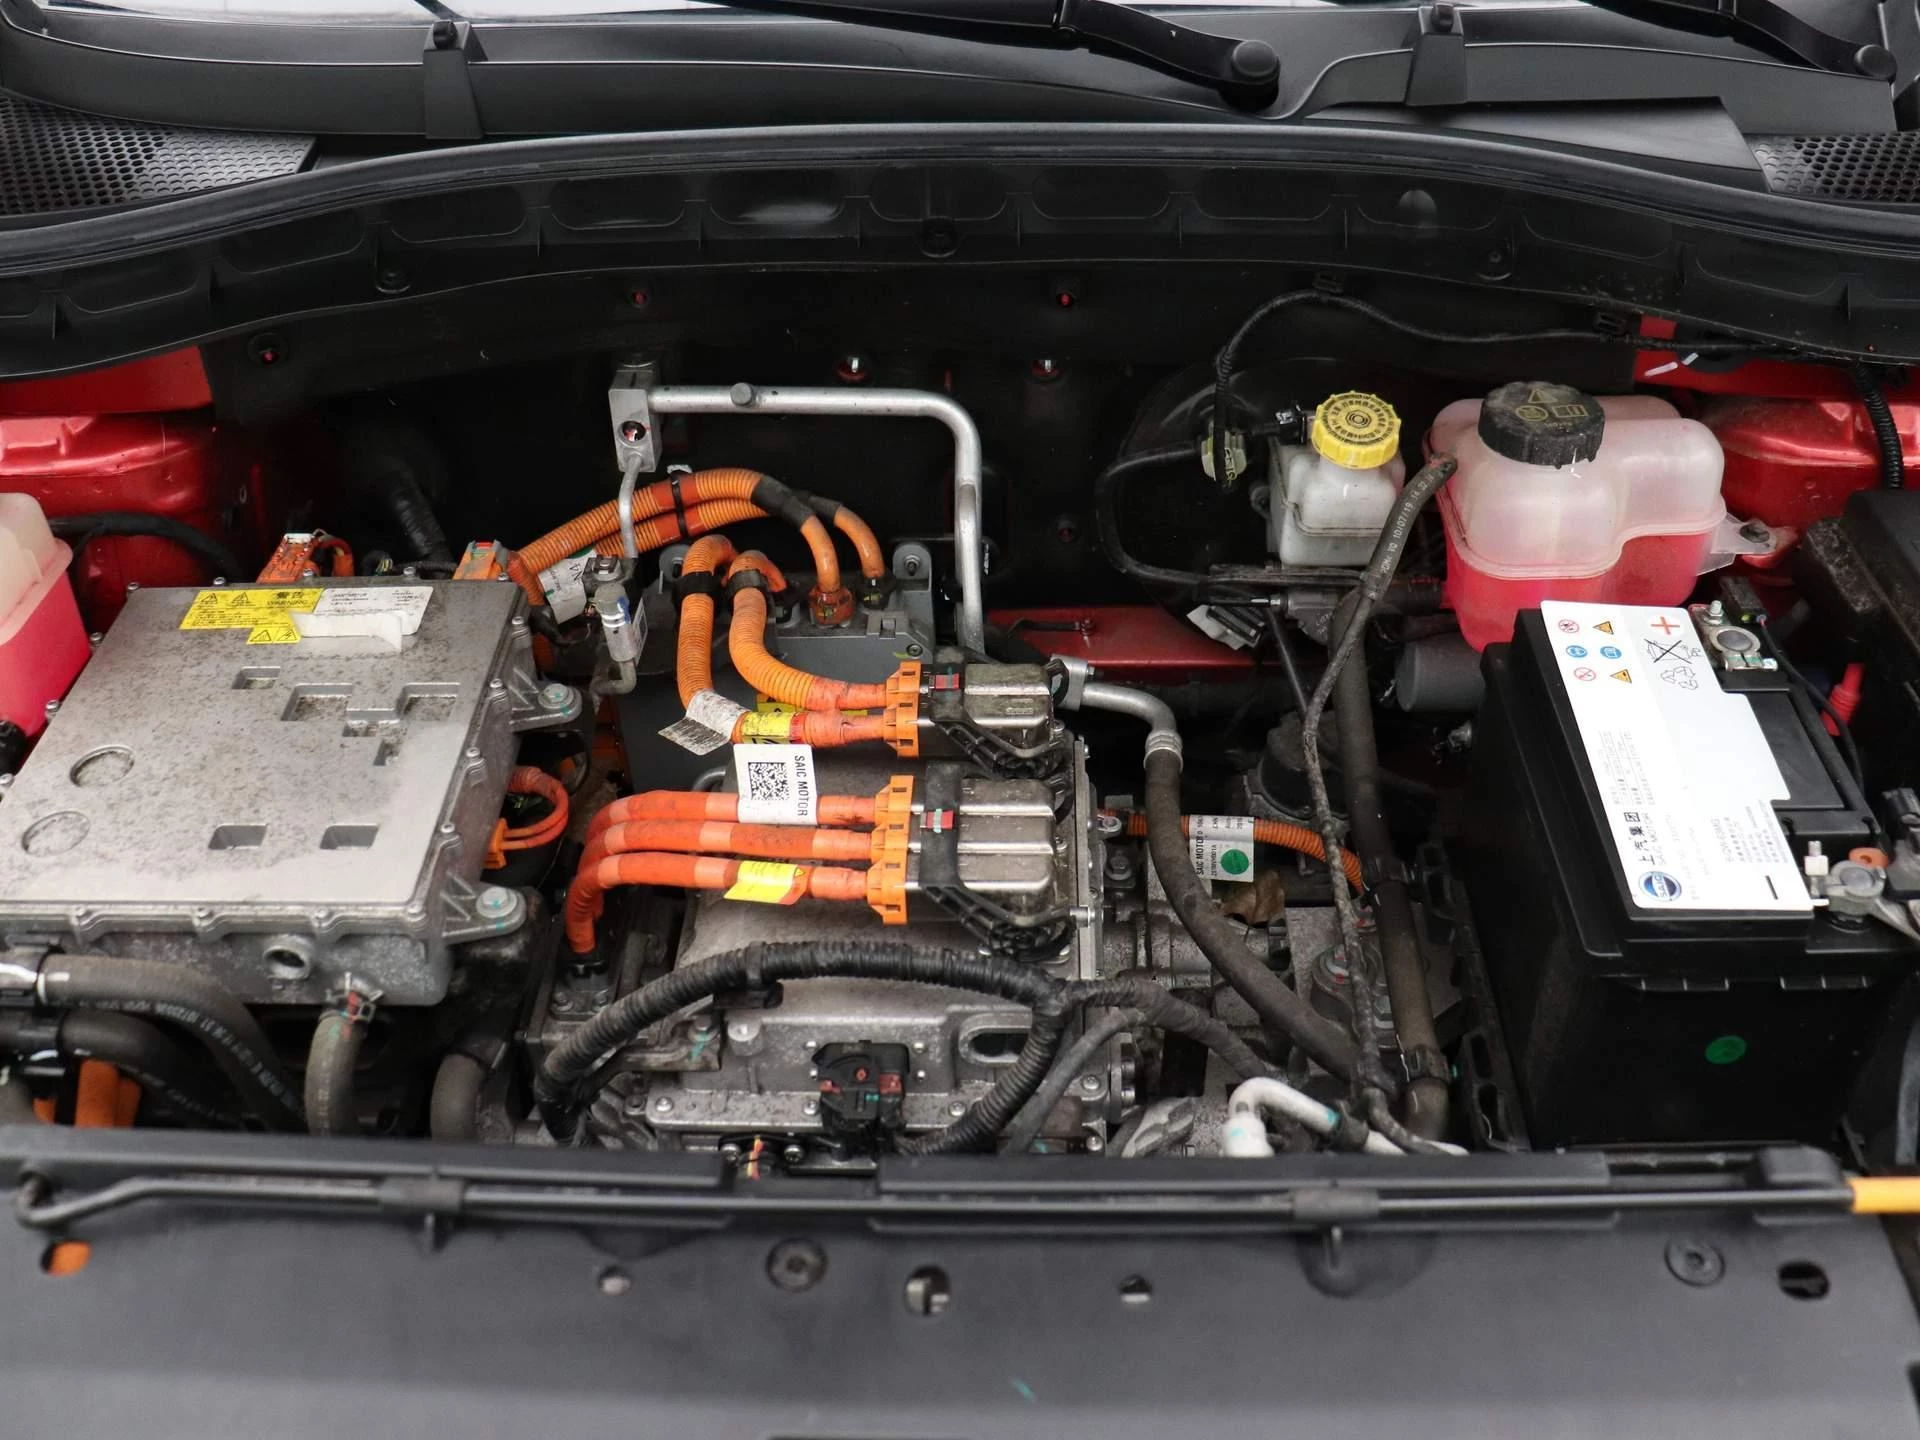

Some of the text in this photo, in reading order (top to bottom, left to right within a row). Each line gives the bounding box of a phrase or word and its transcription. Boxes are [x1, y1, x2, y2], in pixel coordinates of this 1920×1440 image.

[794, 755, 809, 816] SAIC MOTOR
[1623, 811, 1656, 866] 上汽集团
[1195, 861, 1204, 875] SAIC
